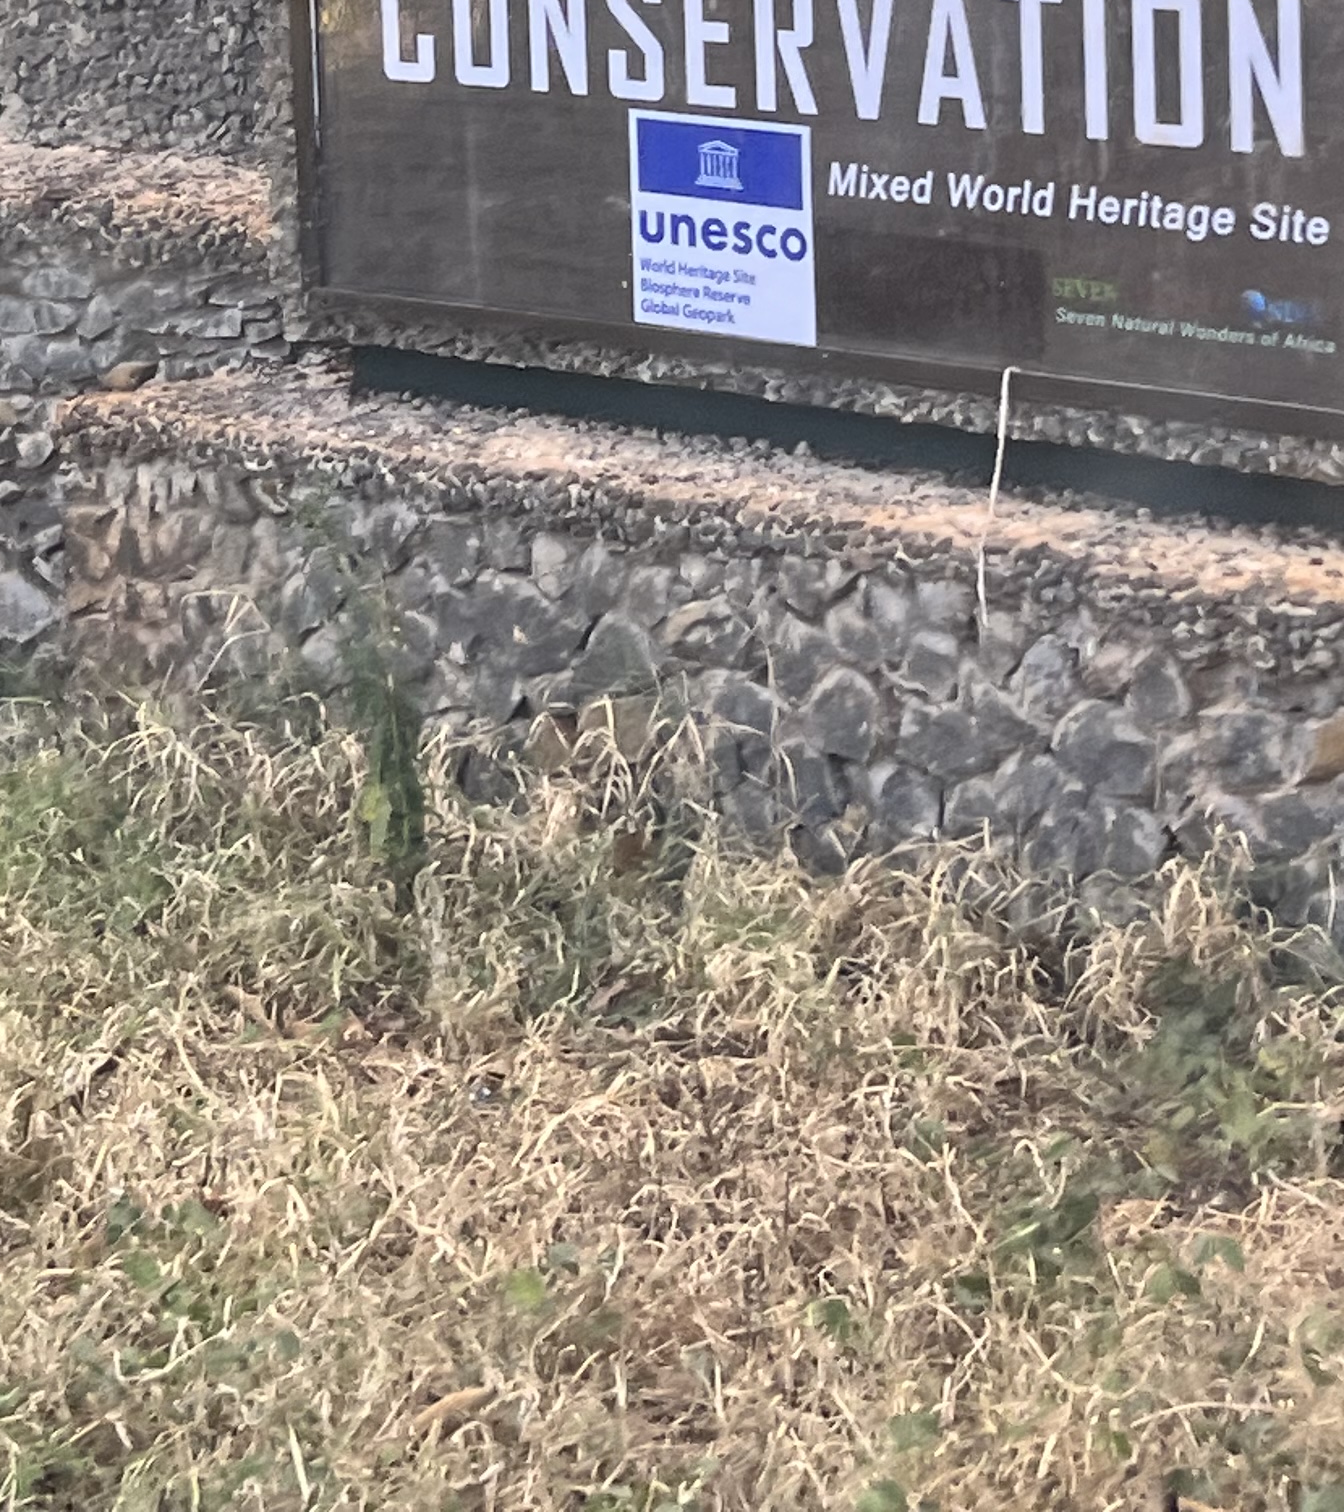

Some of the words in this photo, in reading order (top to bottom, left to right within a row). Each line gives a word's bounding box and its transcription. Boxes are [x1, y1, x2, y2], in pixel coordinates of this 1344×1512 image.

[827, 161, 934, 205] Mixed
[947, 172, 1055, 217] World
[1068, 184, 1236, 242] Heritage
[1249, 201, 1330, 245] Site
[638, 209, 808, 261] unesco
[640, 257, 676, 275] World
[678, 262, 730, 285] Heritage
[733, 269, 756, 285] Site
[640, 277, 700, 298] Biosphere
[702, 285, 751, 306] Reserve
[640, 298, 680, 316] Global
[682, 303, 735, 324] Geopark
[1056, 306, 1106, 328] Seven
[1111, 313, 1175, 336] Natural
[1180, 321, 1255, 345] Wonders
[1260, 330, 1280, 347] of
